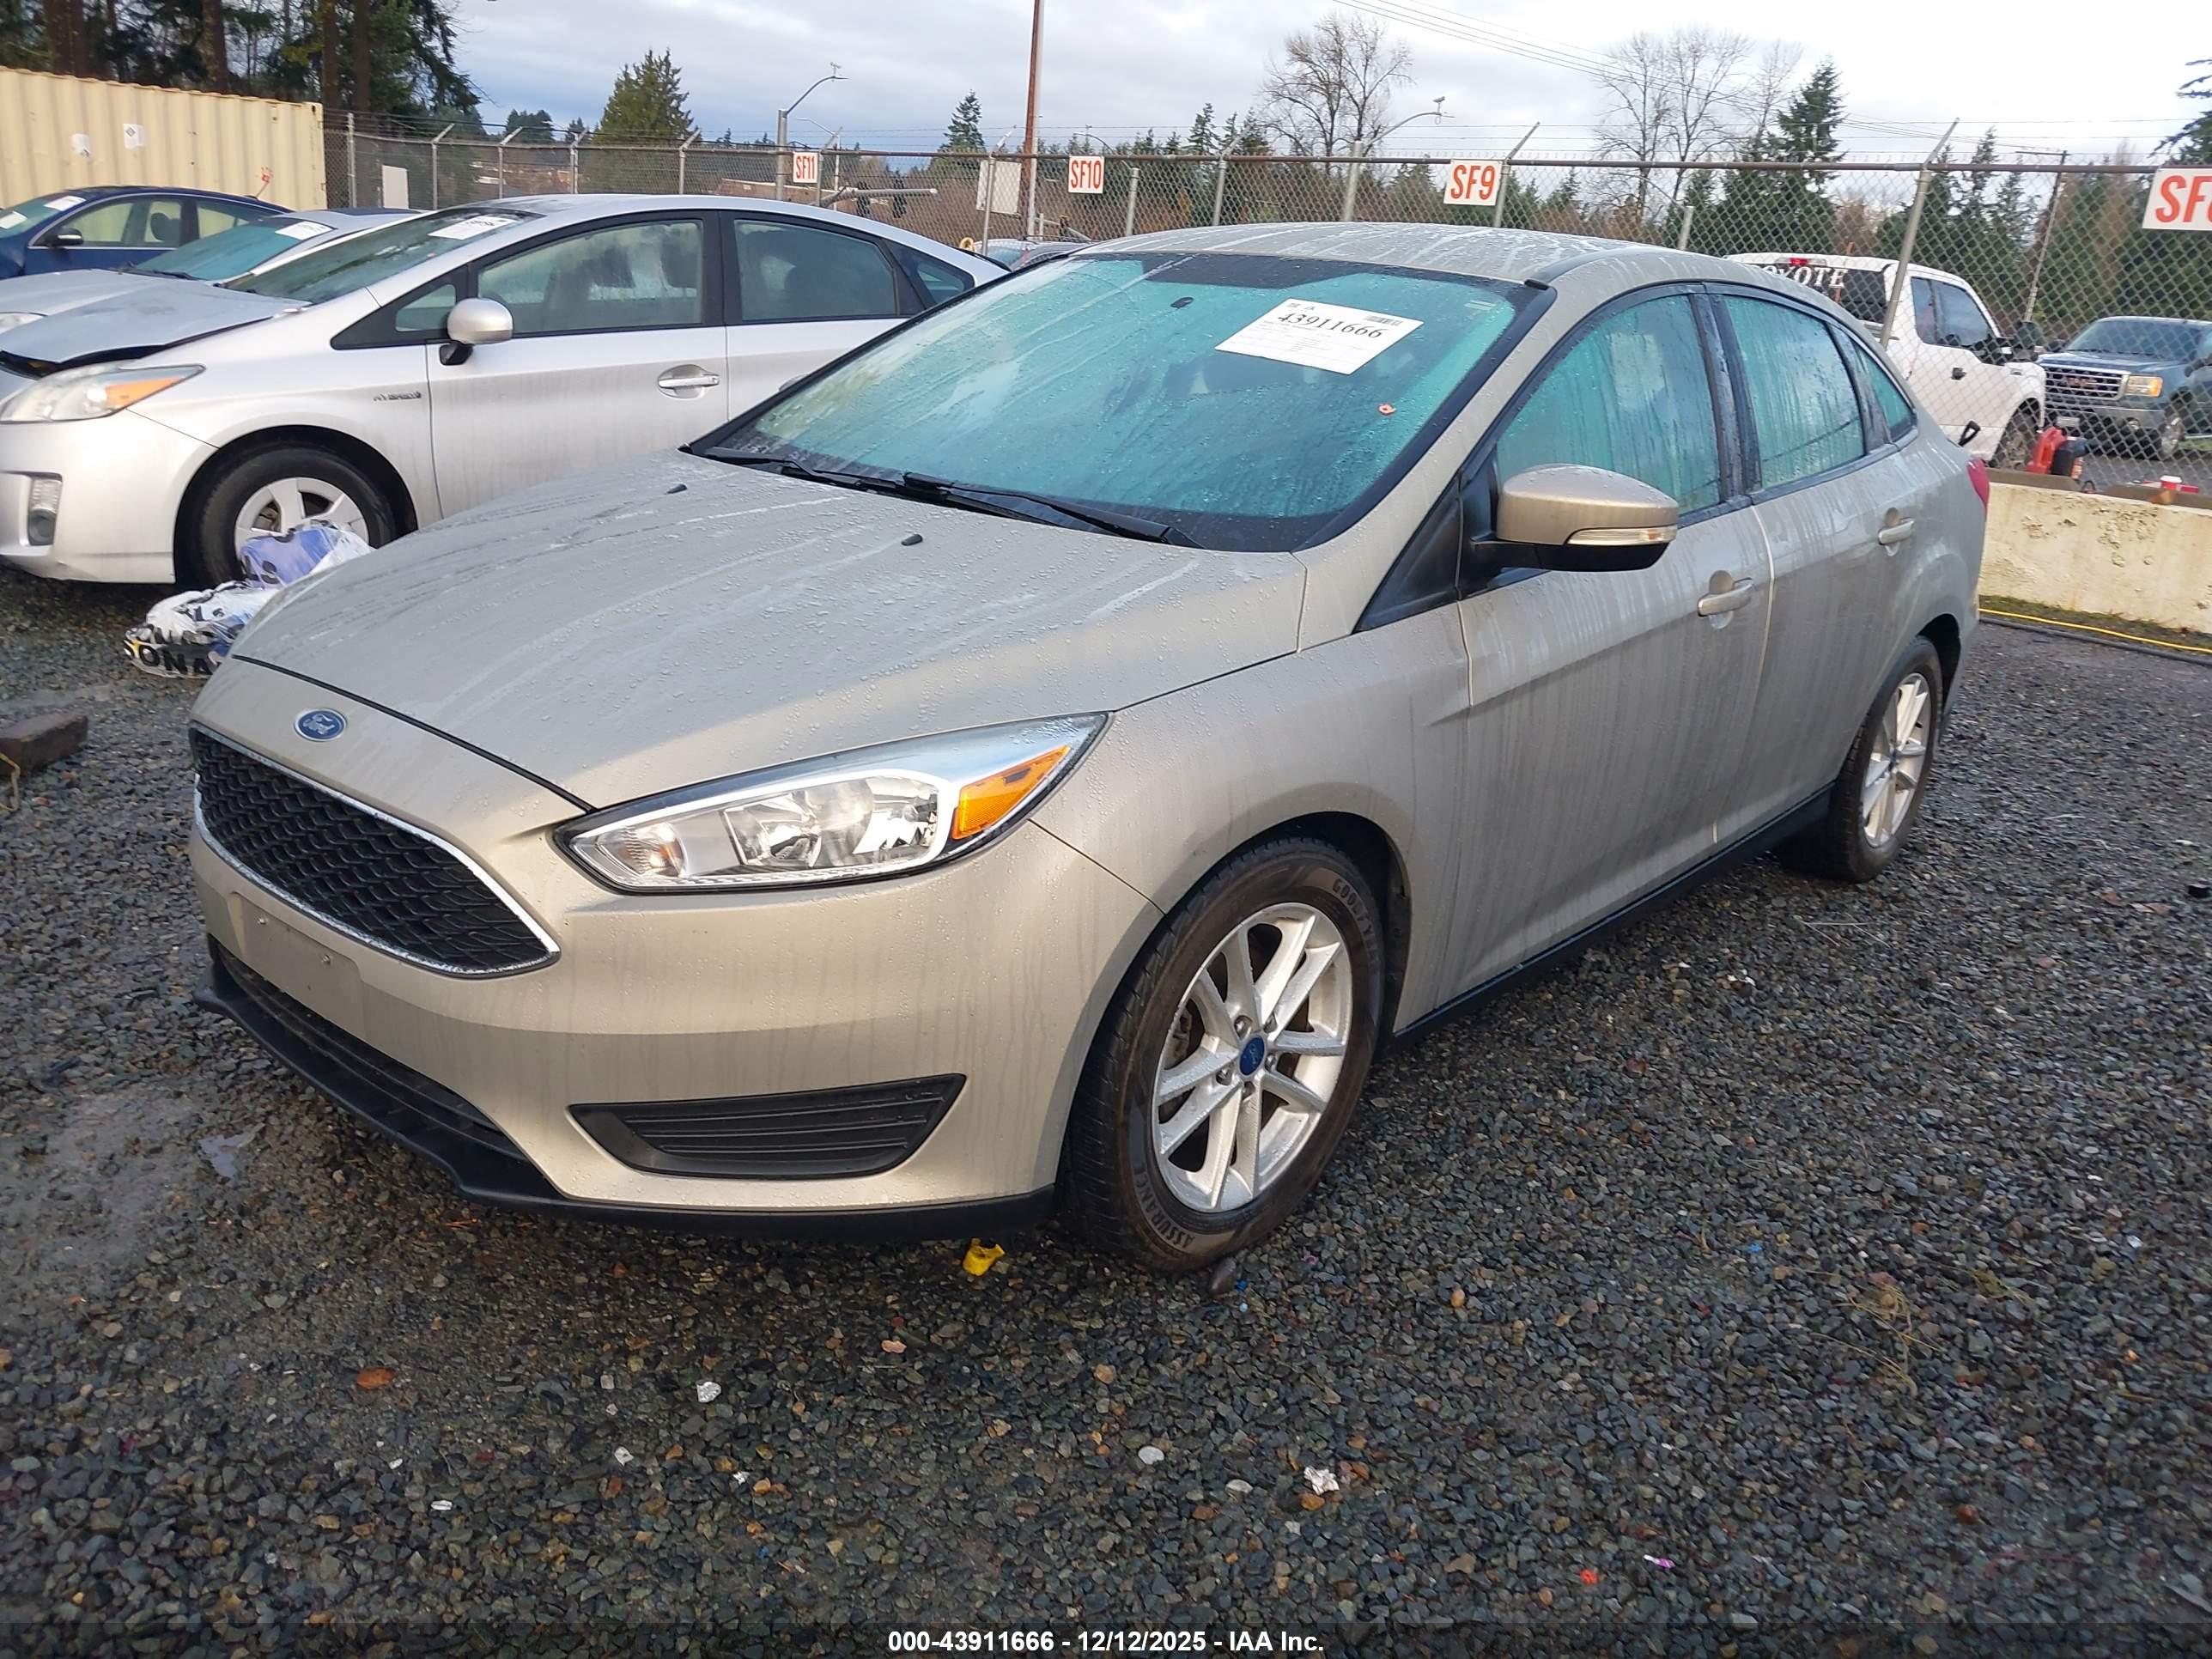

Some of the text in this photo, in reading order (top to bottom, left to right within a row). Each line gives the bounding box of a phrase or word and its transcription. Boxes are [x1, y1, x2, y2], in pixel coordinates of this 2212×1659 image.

[796, 155, 815, 179] SF11
[1071, 160, 1102, 189] SF10
[1450, 164, 1496, 200] SF9
[2155, 175, 2212, 223] SF
[1752, 264, 1848, 288] OYOTE
[1278, 313, 1389, 339] 43911666
